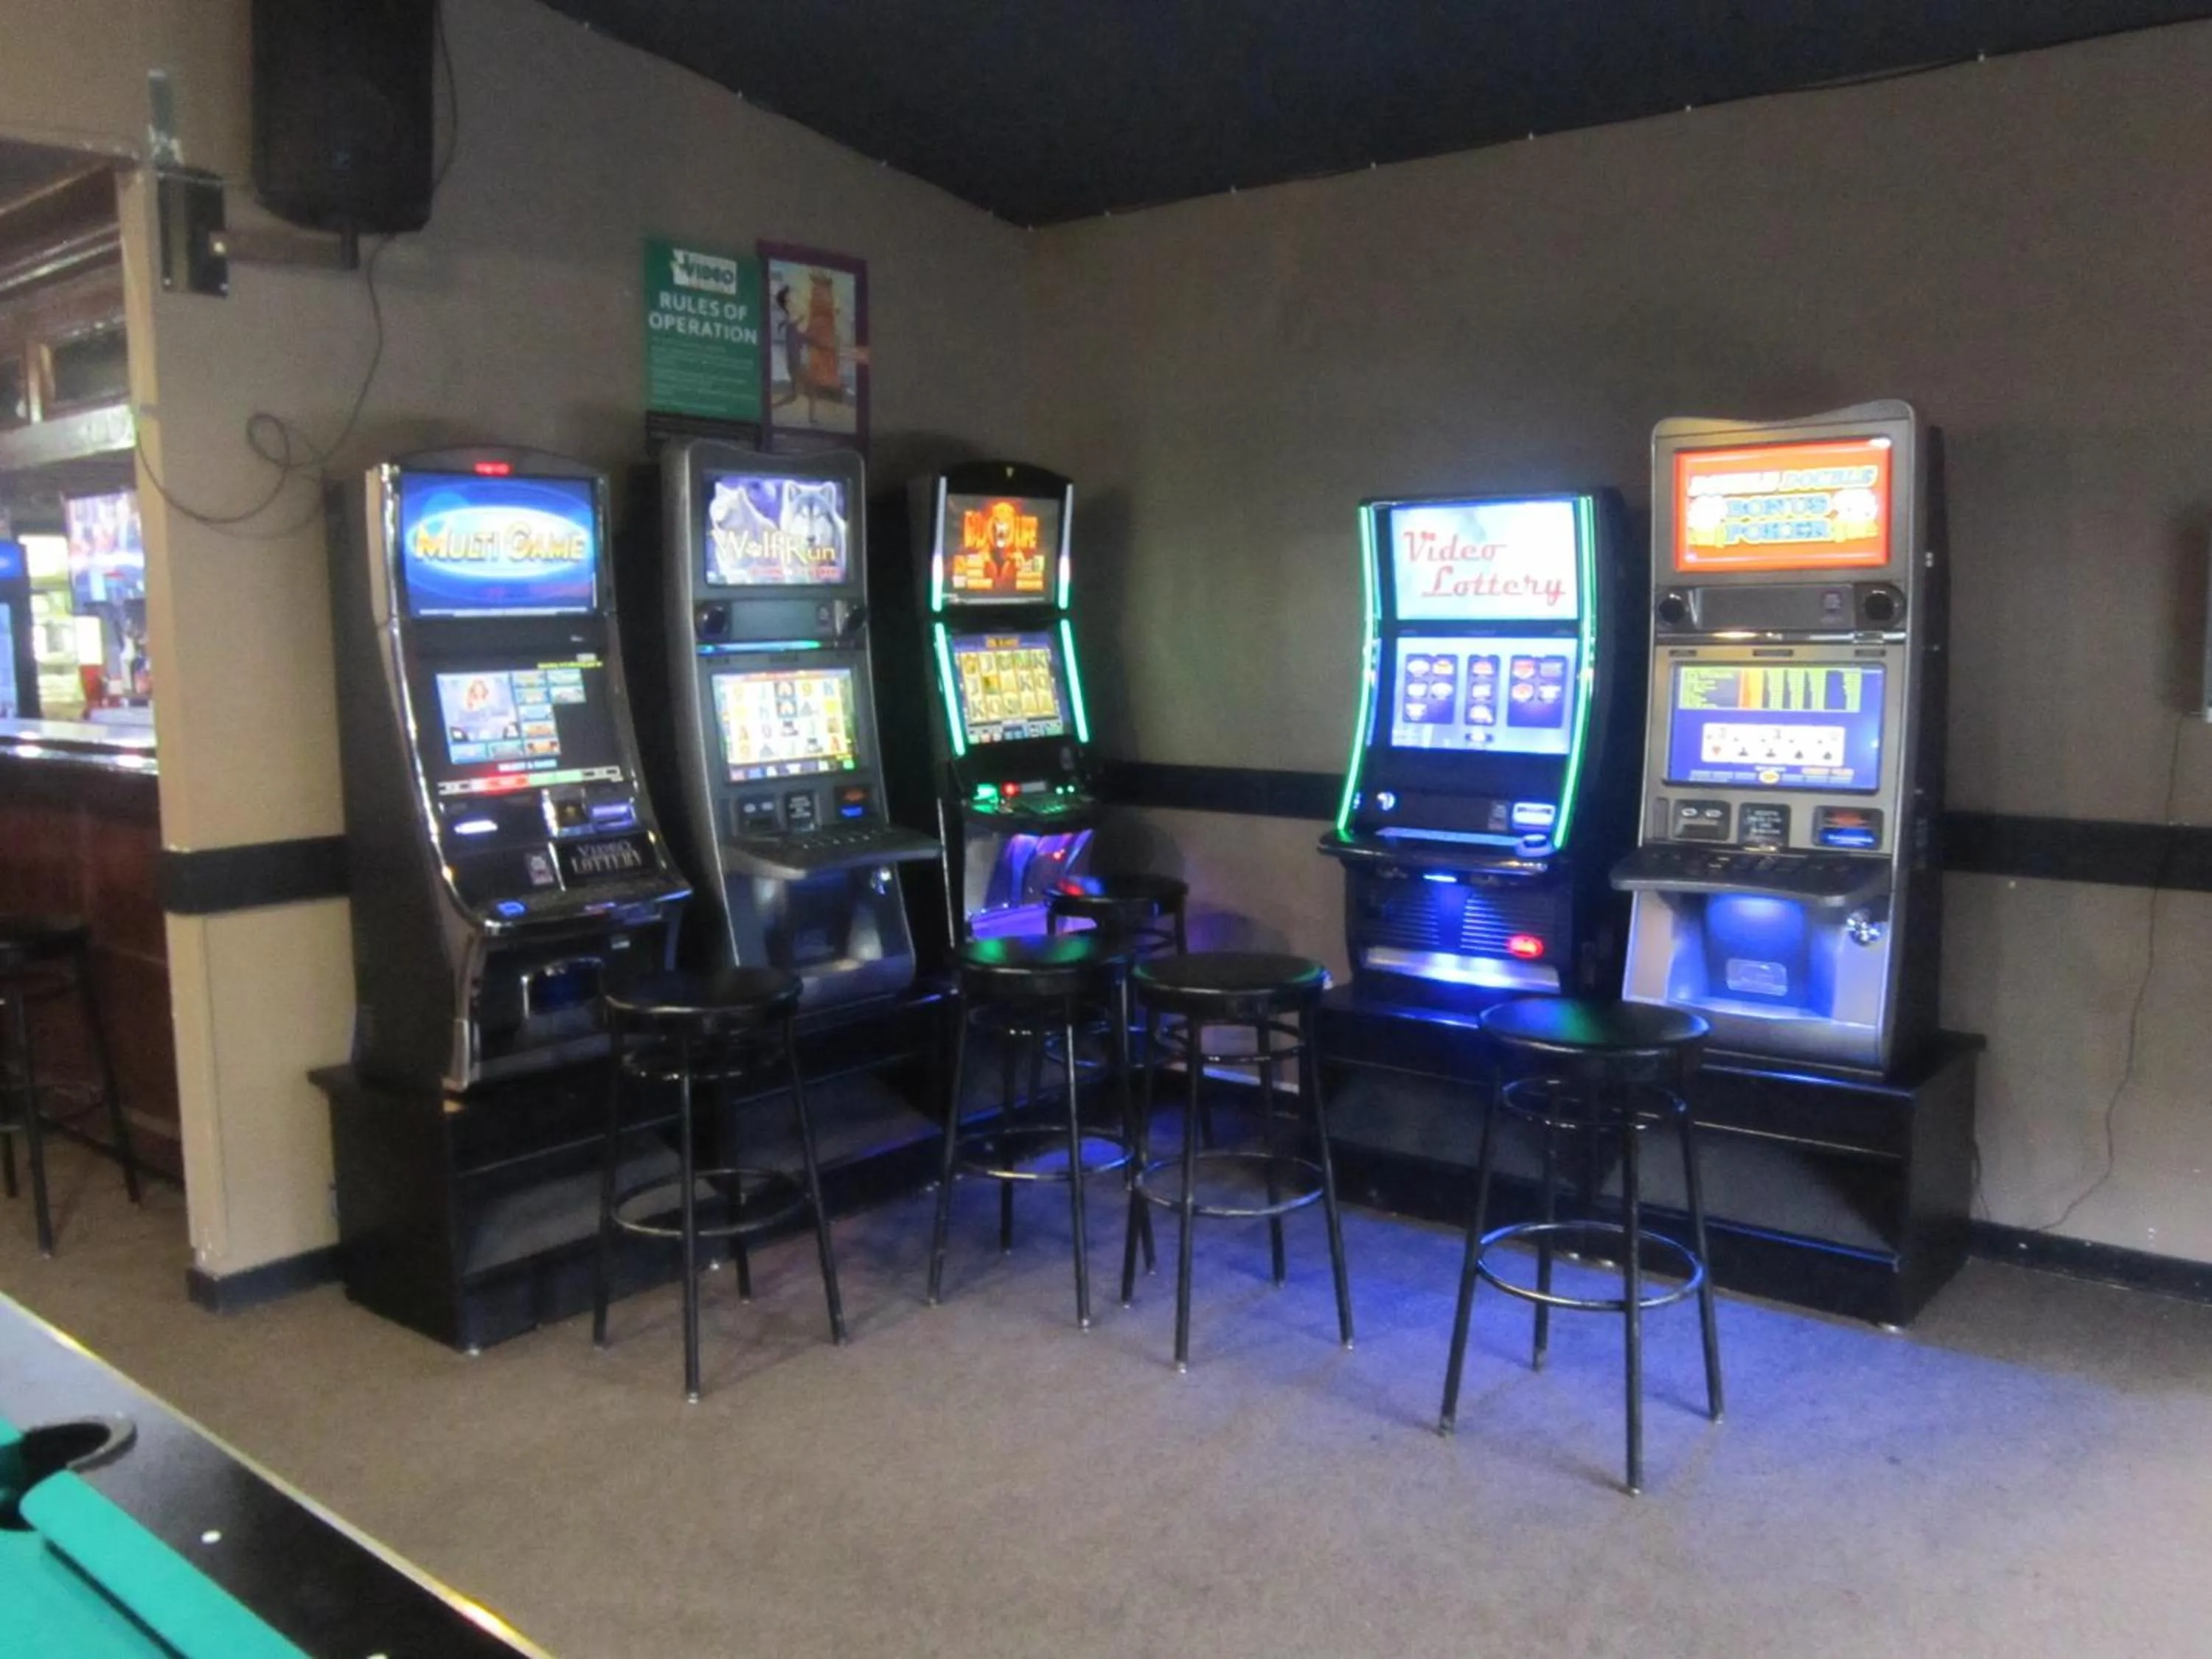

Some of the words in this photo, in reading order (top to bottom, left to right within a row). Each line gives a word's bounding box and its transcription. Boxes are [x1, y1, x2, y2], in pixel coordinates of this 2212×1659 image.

[659, 291, 720, 317] RULES
[723, 302, 748, 321] OF
[649, 311, 758, 345] OPERATION
[1725, 495, 1828, 517] BONUS
[415, 520, 501, 563] MULTI
[507, 521, 588, 563] GAME
[1724, 520, 1828, 542] POKER
[1403, 531, 1507, 563] Video
[1421, 565, 1565, 606] Lottery
[570, 849, 642, 874] LOTTERY
